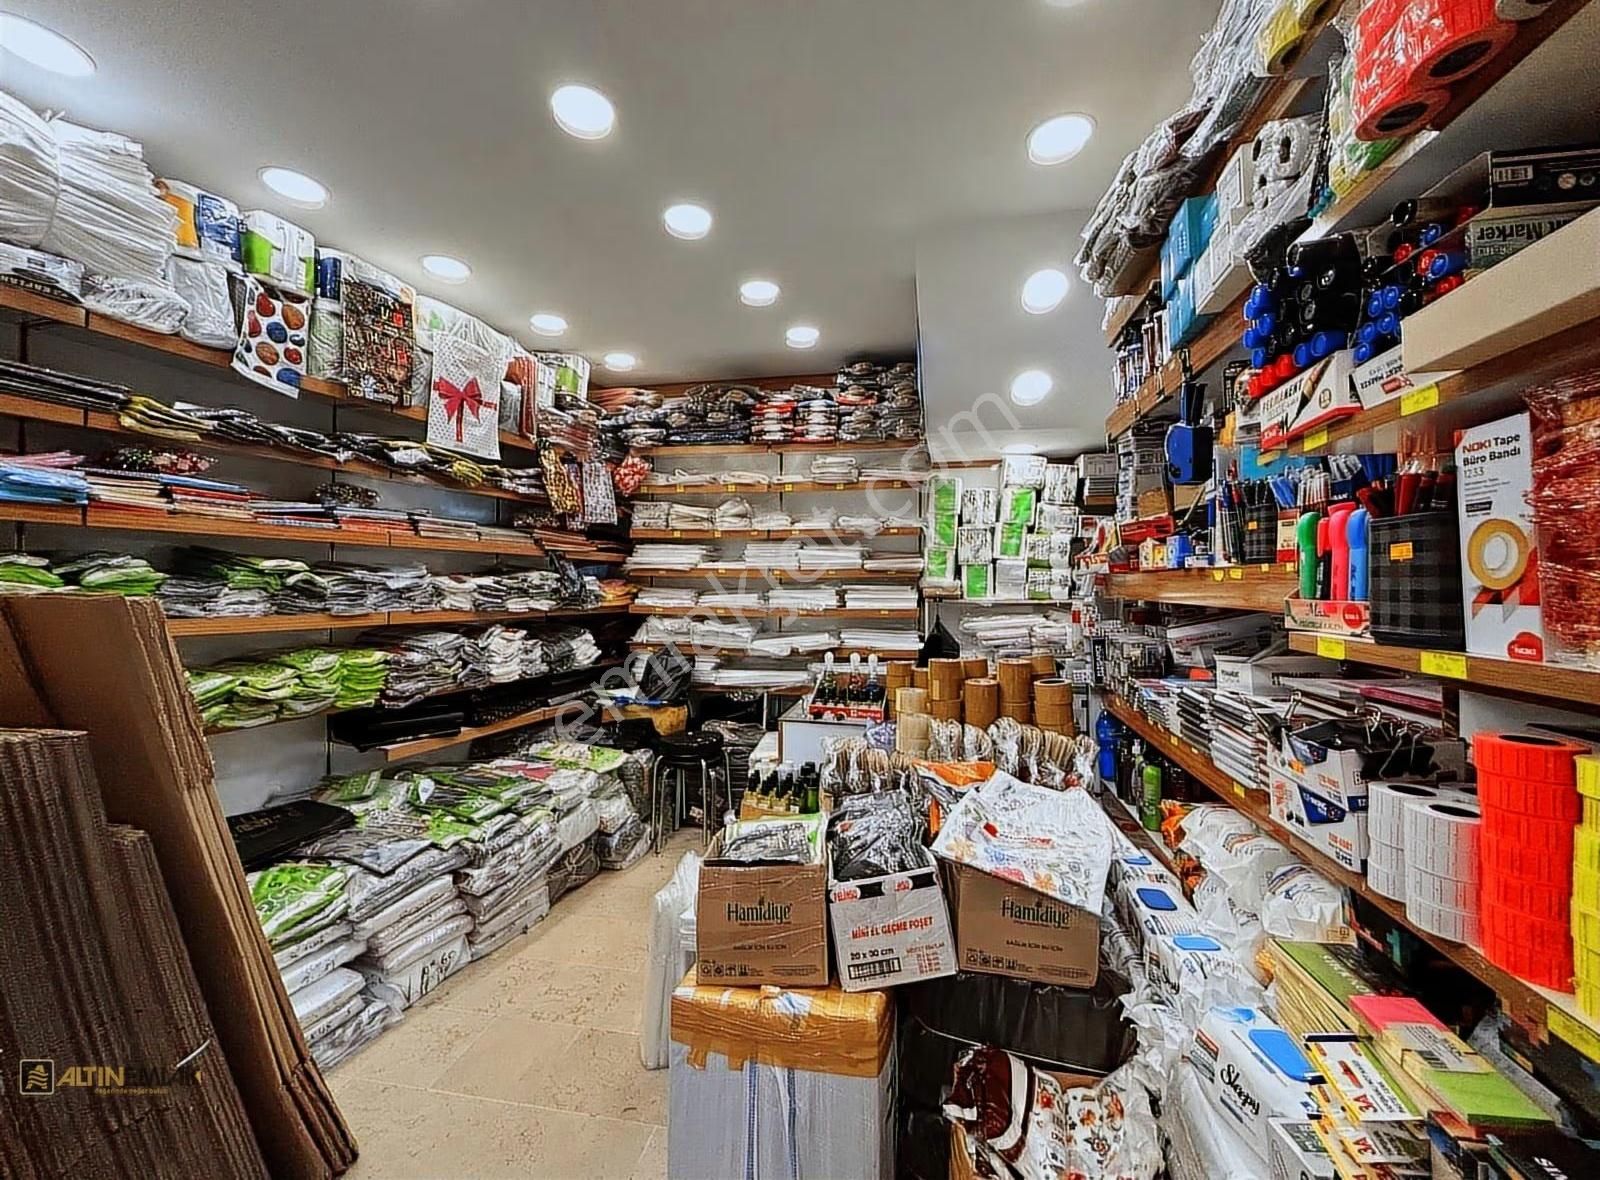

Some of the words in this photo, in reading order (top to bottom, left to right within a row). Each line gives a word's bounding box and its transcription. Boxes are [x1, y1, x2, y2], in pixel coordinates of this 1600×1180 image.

[1462, 439, 1491, 453] NOKI
[1493, 434, 1520, 446] Tape
[1463, 455, 1487, 466] Büro
[1489, 446, 1521, 461] Bandı
[727, 900, 792, 924] Hamidiye
[1002, 899, 1071, 929] Hamidiye
[881, 948, 894, 957] cm
